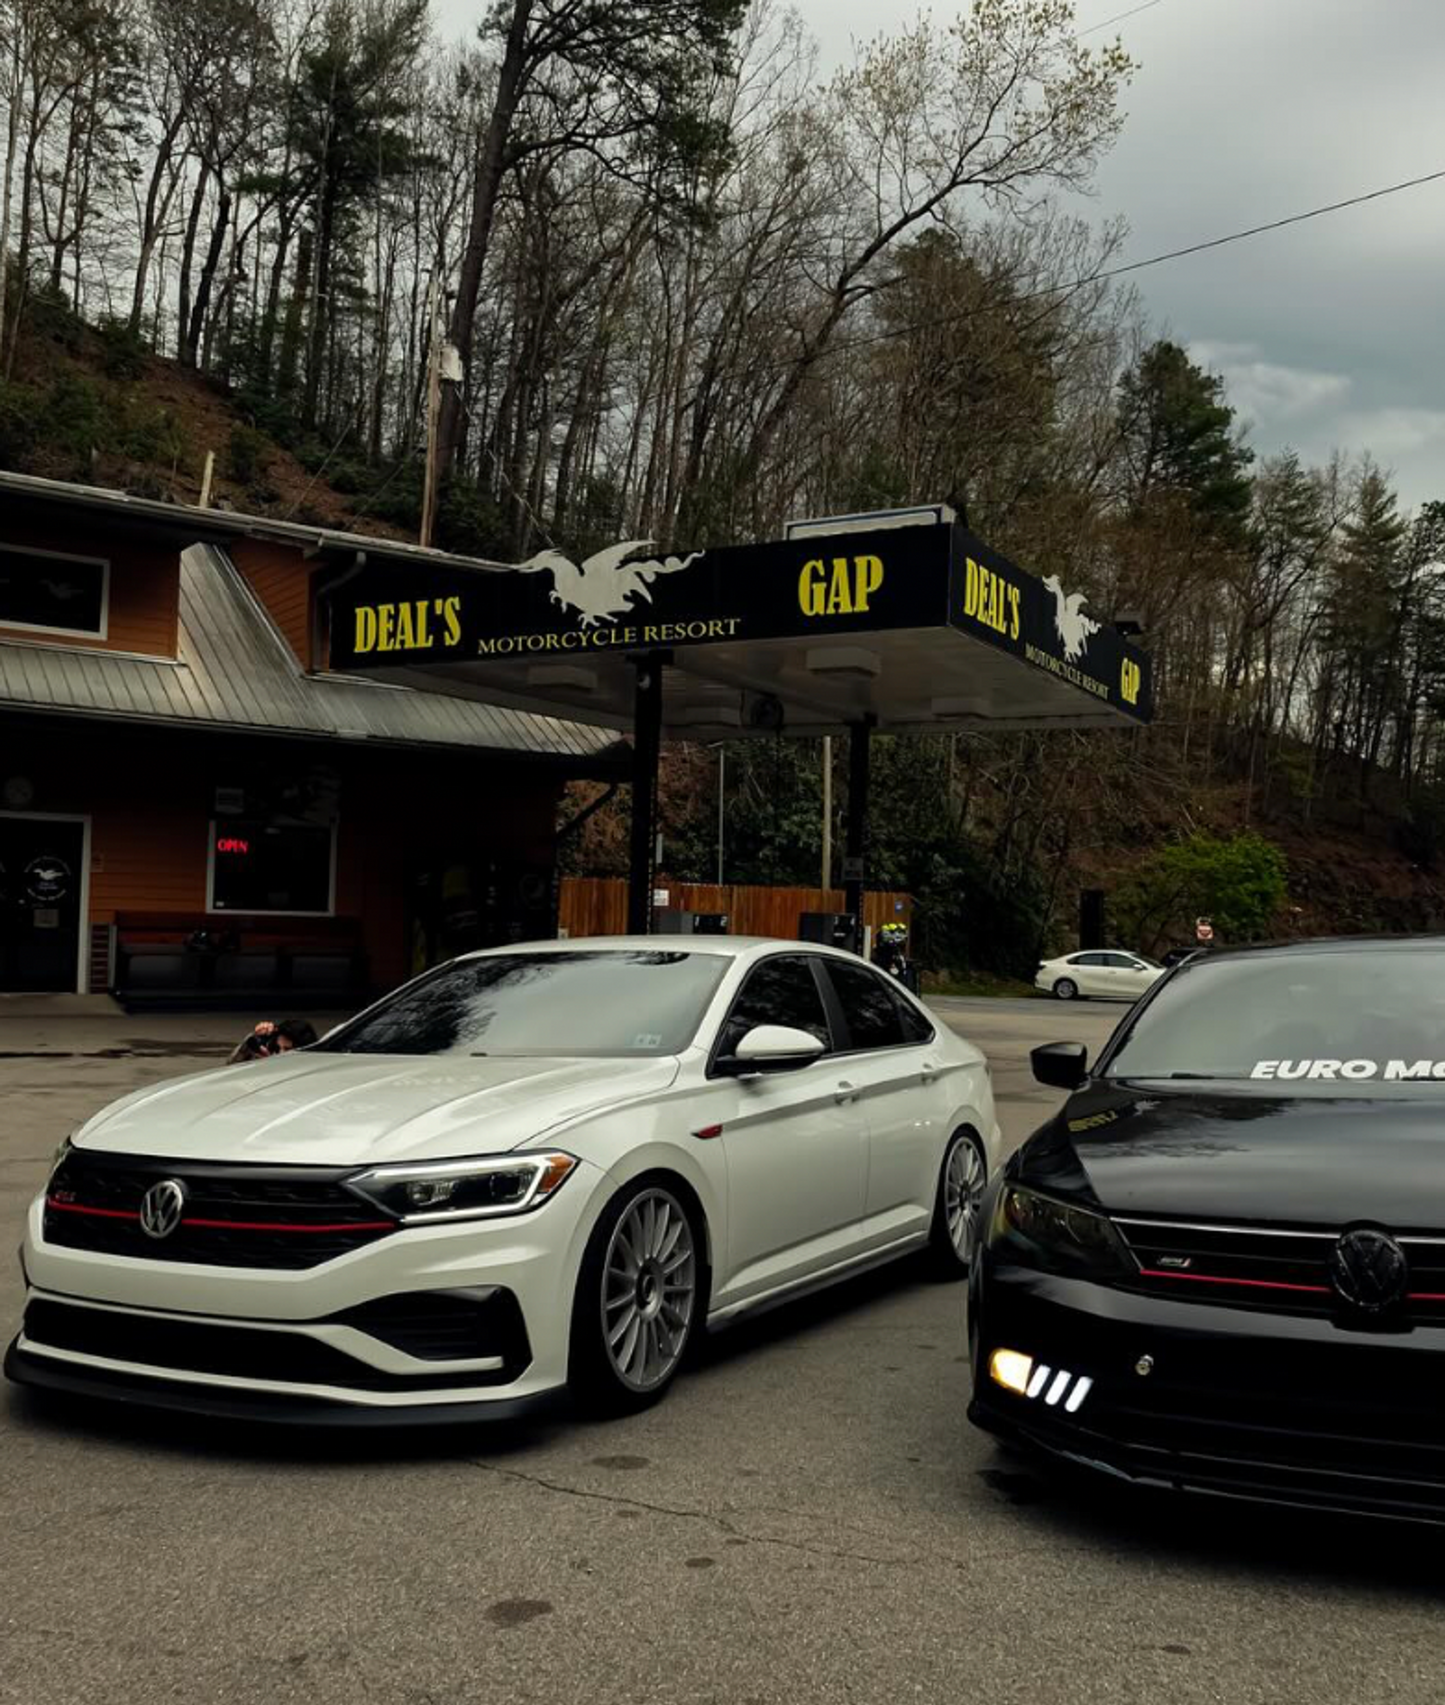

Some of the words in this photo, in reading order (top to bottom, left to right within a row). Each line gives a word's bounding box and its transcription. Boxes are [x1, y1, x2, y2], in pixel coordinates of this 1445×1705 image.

[798, 555, 884, 616] GAP
[963, 557, 1021, 641] DEAL'S
[353, 596, 462, 654] DEAL'S
[477, 627, 637, 655] MOTORCYCLE
[643, 618, 742, 642] RESORT
[1120, 657, 1141, 705] GAP
[216, 837, 249, 854] OPEN
[1250, 1060, 1378, 1080] EURO
